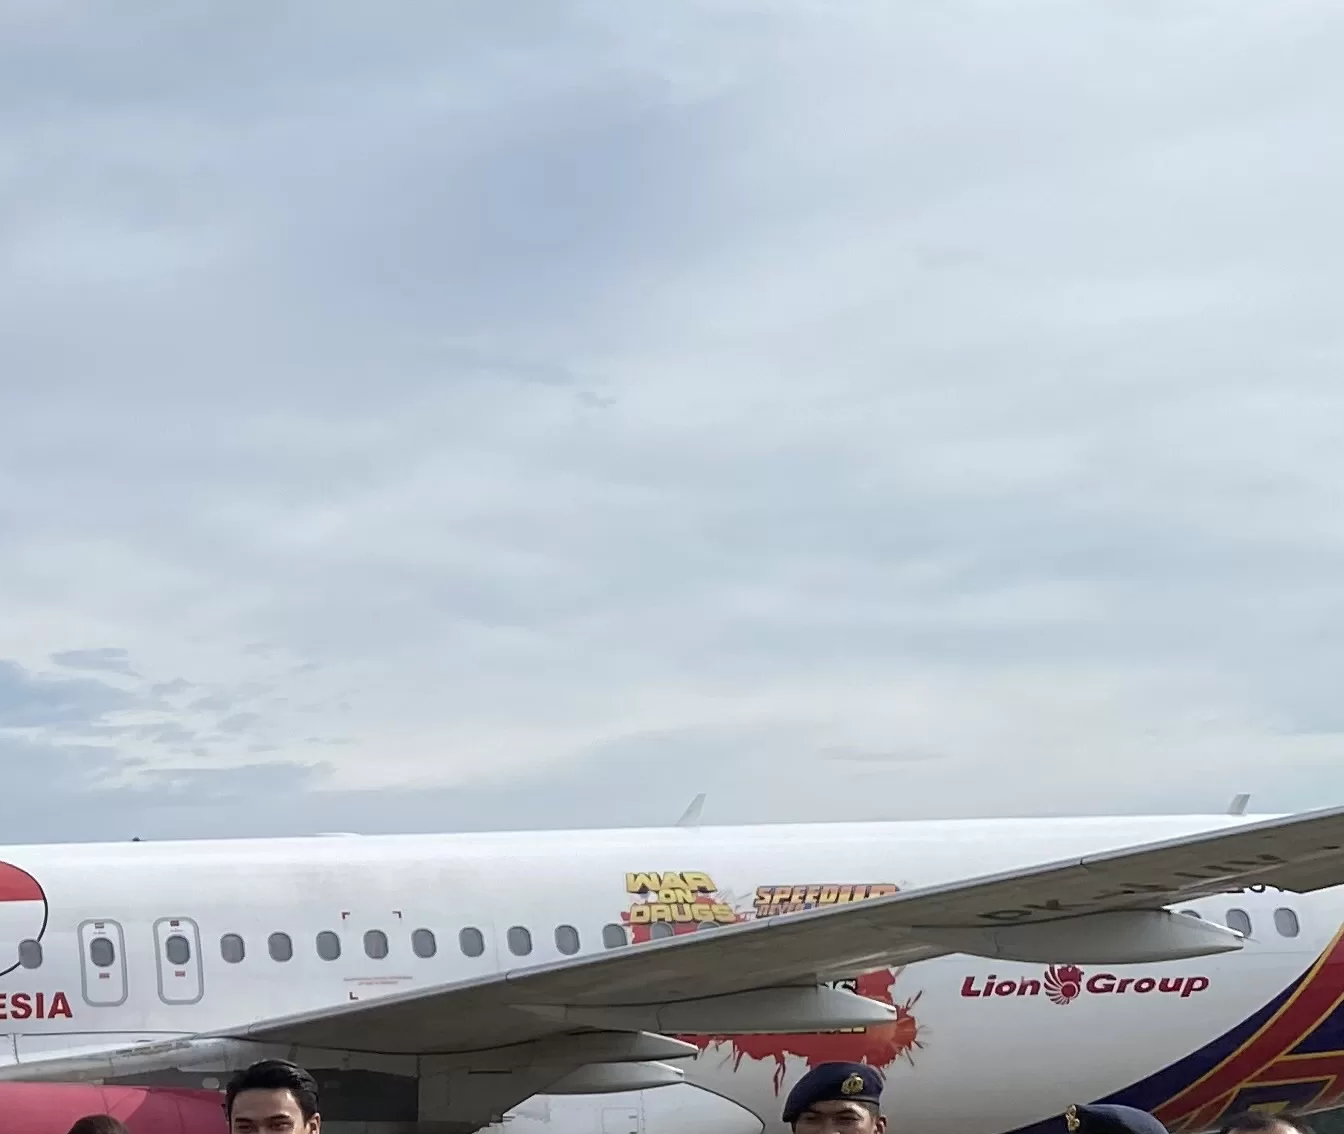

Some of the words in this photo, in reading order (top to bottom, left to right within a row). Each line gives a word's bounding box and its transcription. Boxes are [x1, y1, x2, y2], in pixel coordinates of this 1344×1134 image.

[626, 872, 718, 893] WAR
[658, 888, 696, 904] ON
[630, 903, 736, 924] DRUGS
[961, 974, 1040, 997] Lion
[1086, 973, 1210, 998] Group
